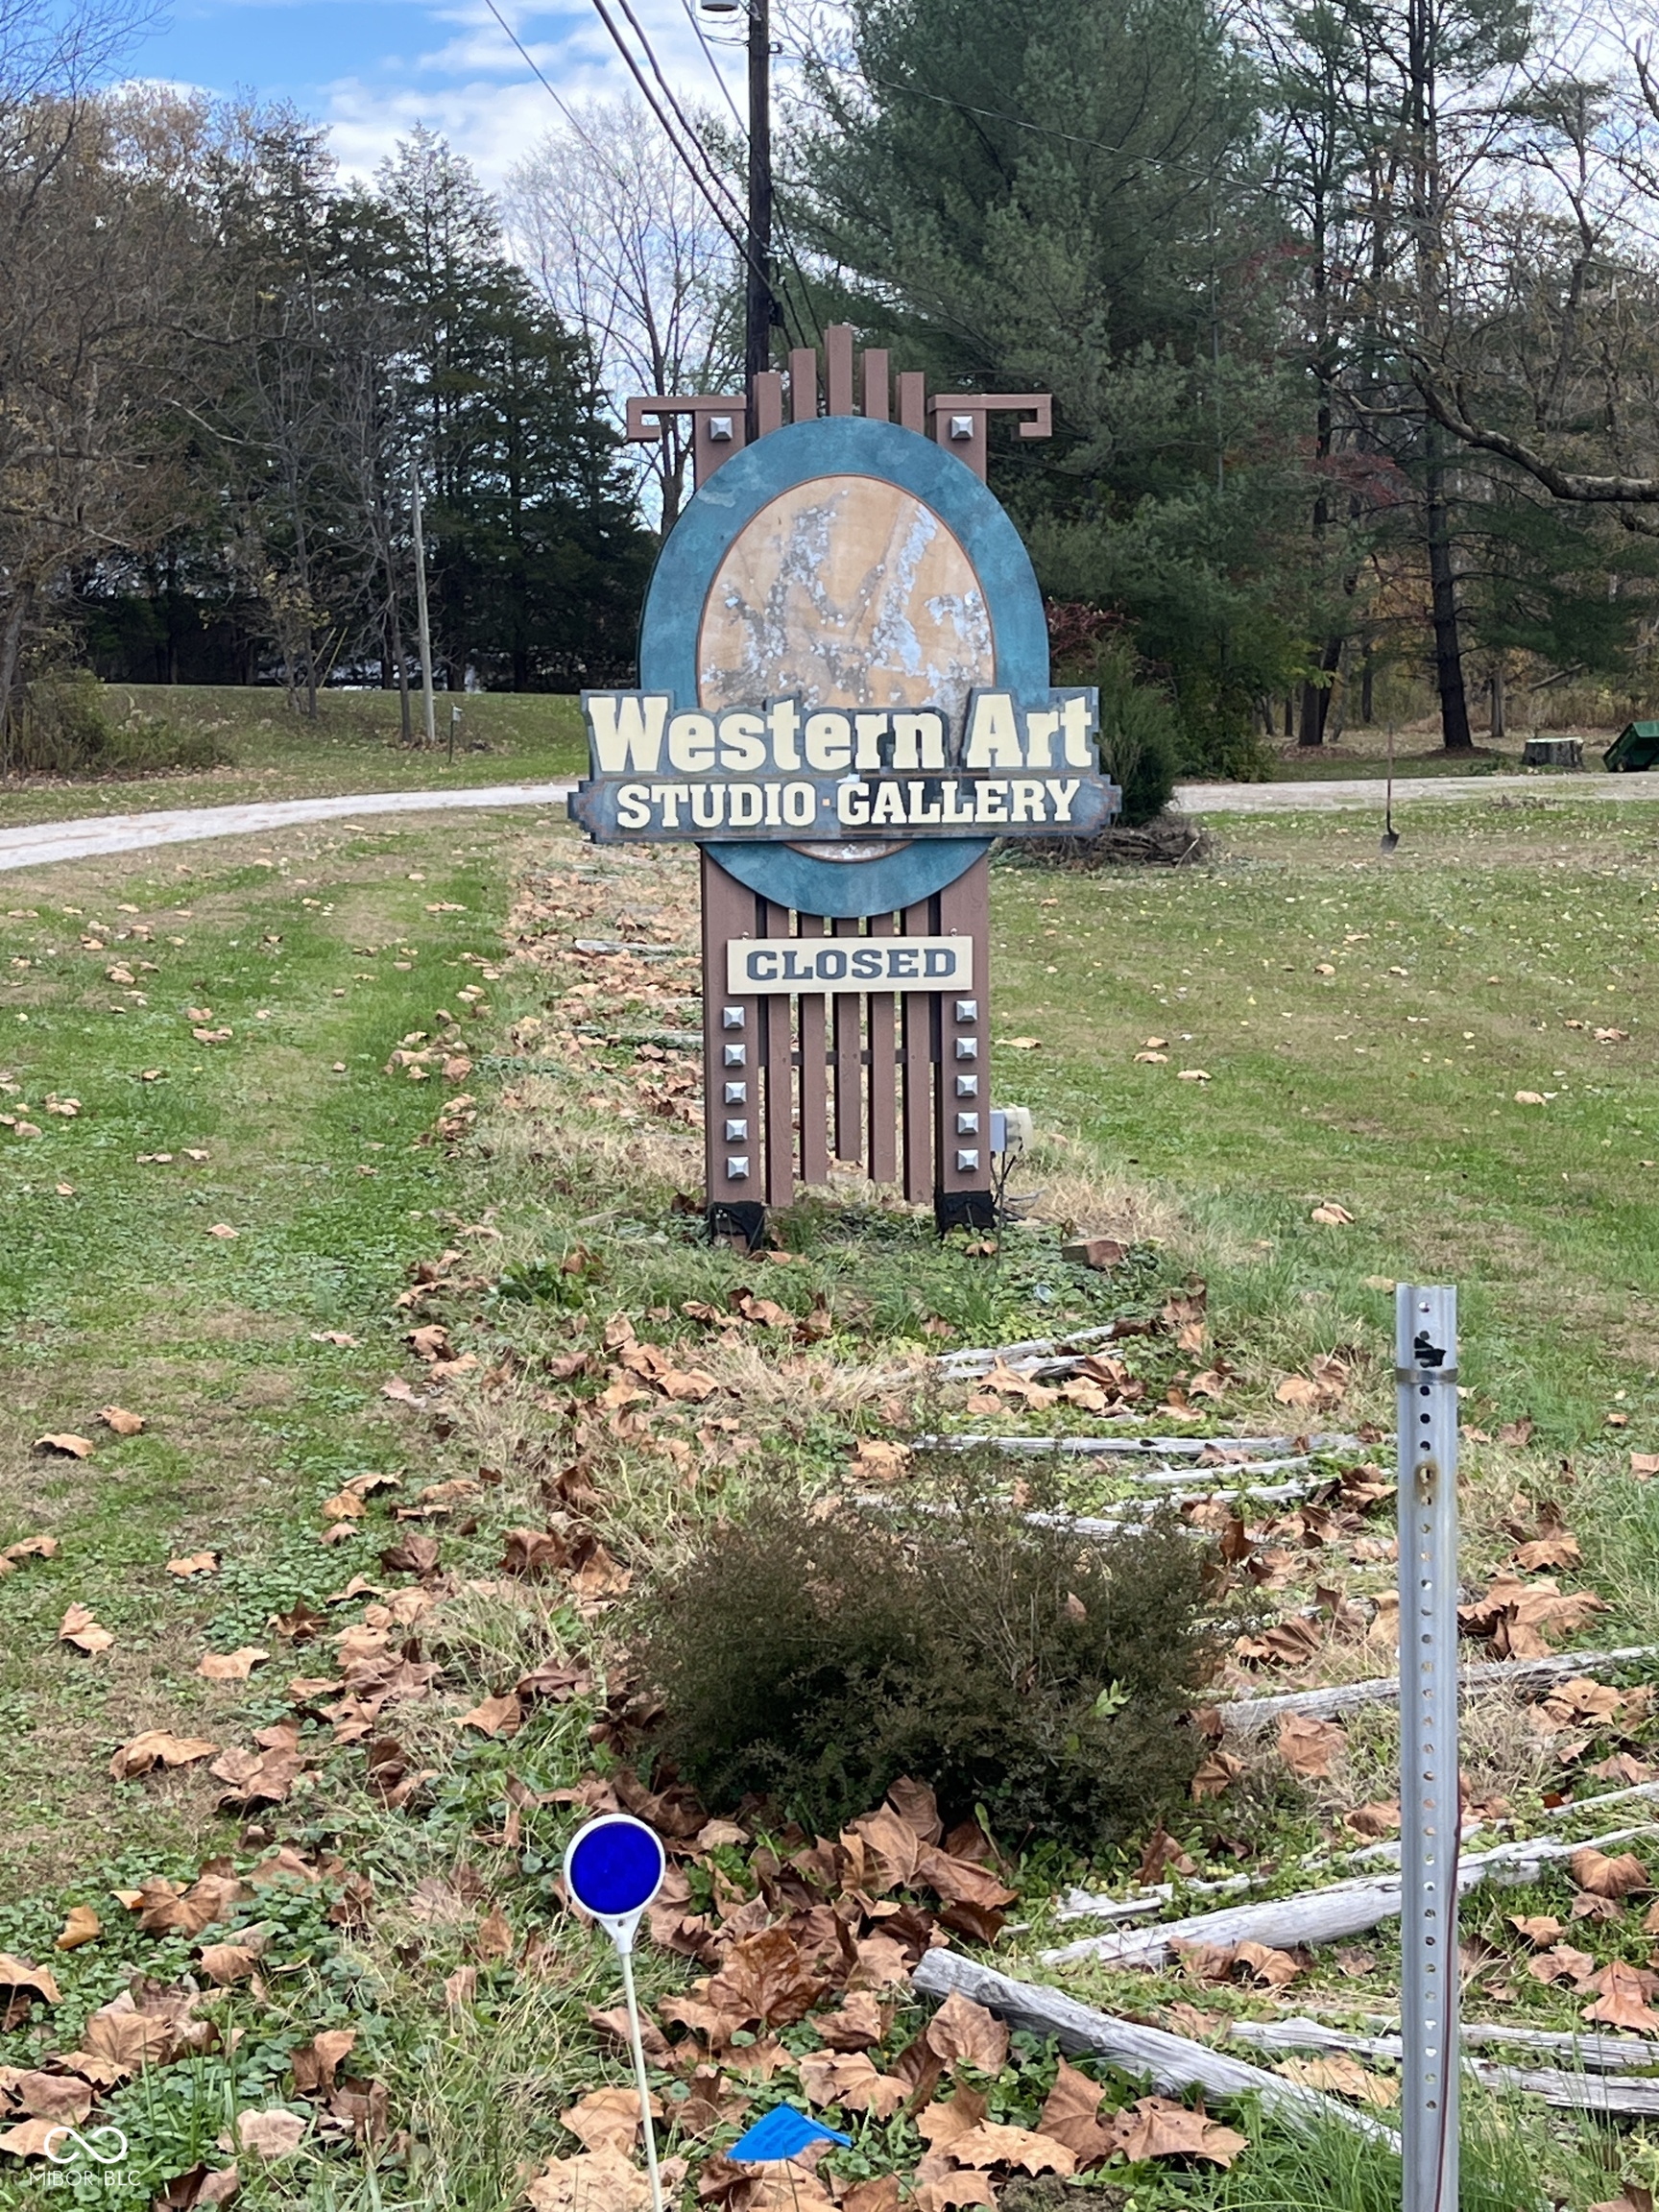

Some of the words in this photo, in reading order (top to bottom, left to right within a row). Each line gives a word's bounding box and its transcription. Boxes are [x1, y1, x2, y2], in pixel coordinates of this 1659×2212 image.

[588, 695, 948, 772] Western
[965, 693, 1094, 768] Art
[615, 781, 817, 830] STUDIO
[836, 779, 1082, 827] GALLERY
[746, 948, 956, 980] CLOSED
